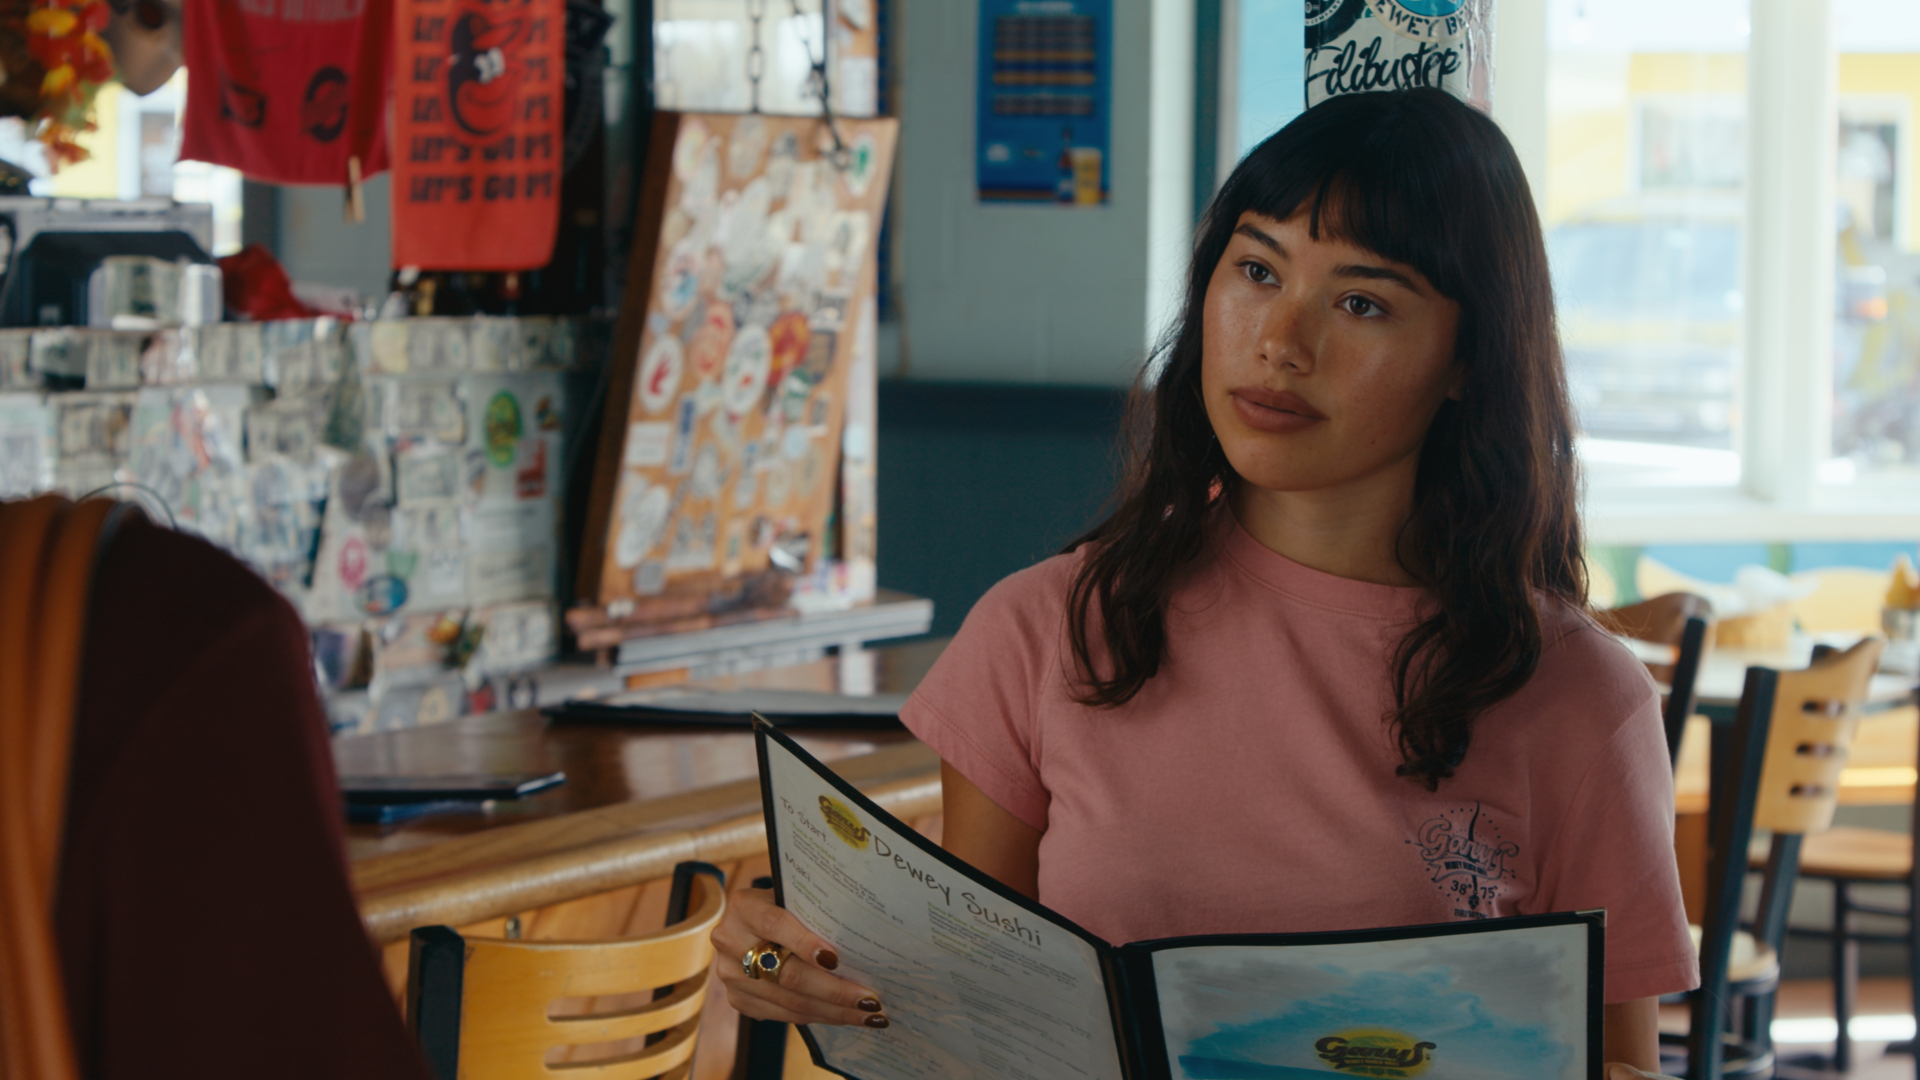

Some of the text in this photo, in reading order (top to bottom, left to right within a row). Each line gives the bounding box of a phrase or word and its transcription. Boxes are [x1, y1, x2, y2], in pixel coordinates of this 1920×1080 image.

[1374, 0, 1440, 37] EWEY
[780, 796, 794, 815] To
[785, 853, 811, 883] Maki
[874, 834, 950, 906] Dewey
[961, 892, 1042, 946] Sushi
